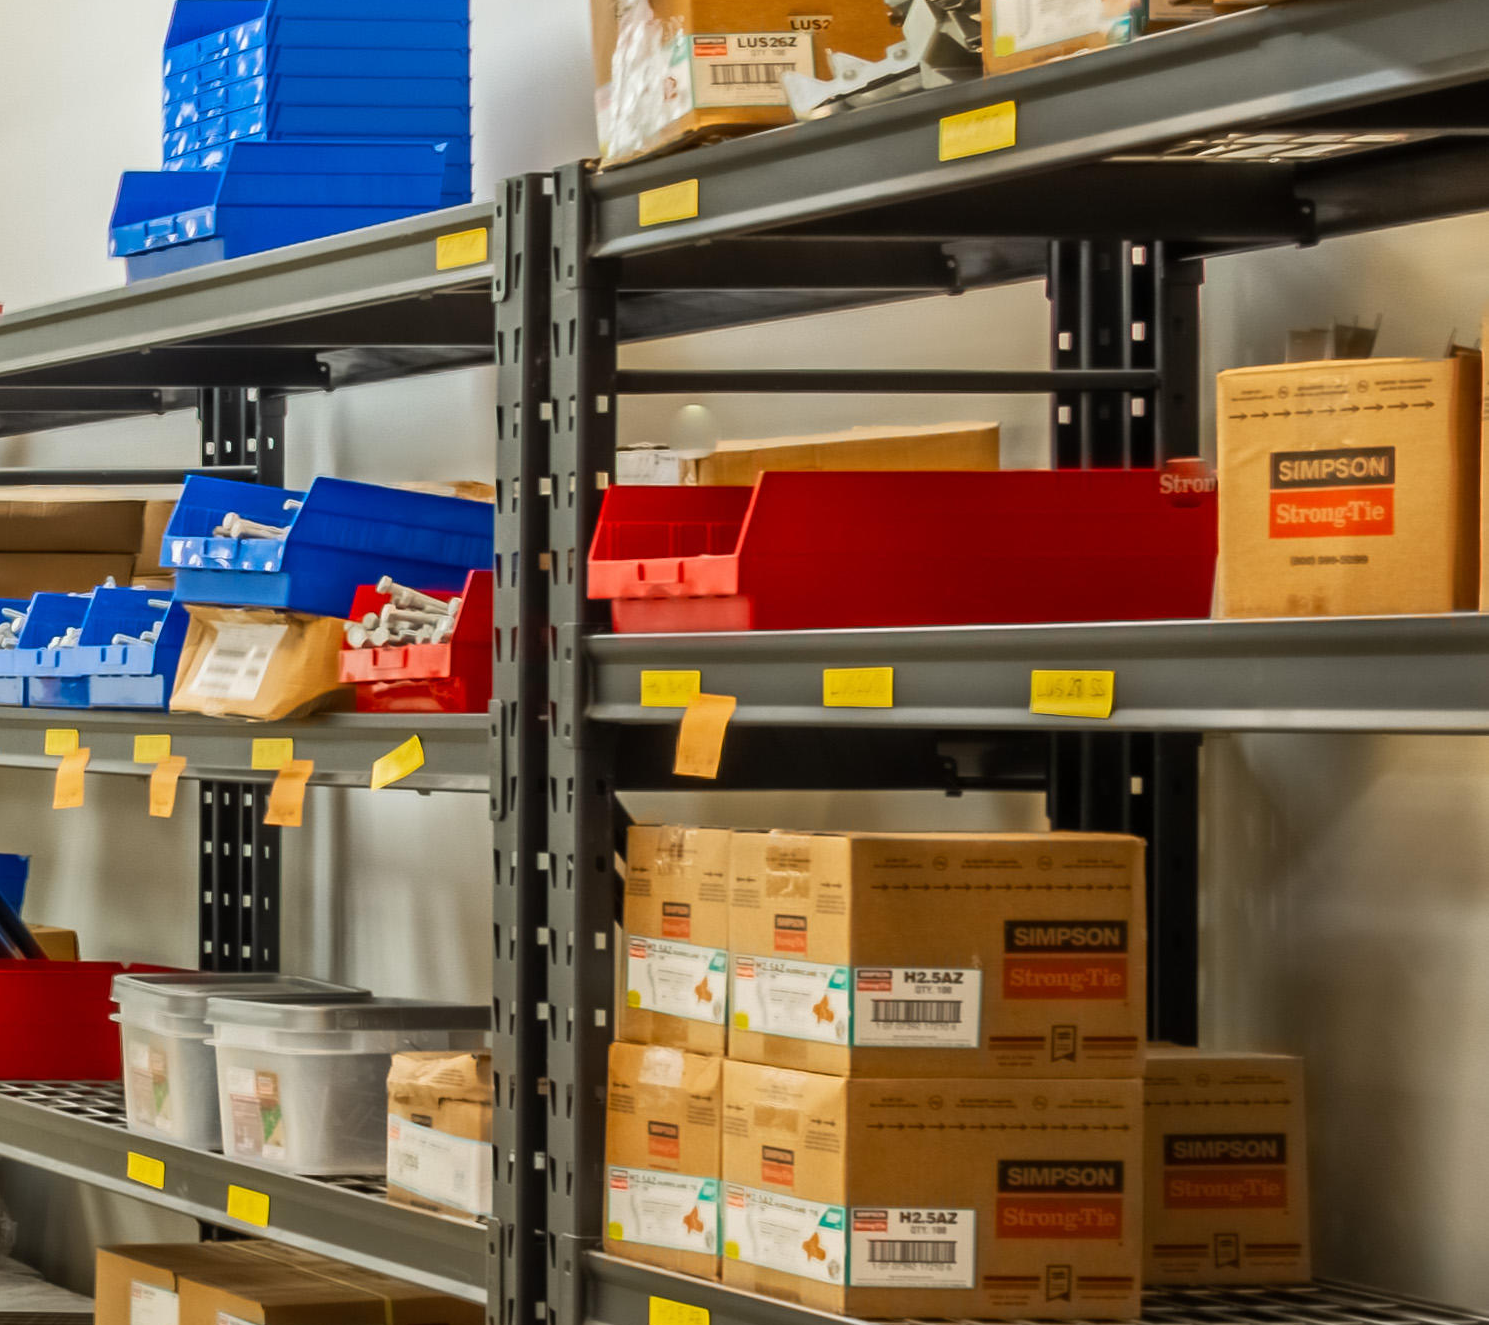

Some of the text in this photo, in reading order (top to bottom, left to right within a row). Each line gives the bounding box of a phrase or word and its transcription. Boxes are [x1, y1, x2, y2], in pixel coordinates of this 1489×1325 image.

[737, 36, 798, 49] LUS26Z
[1279, 457, 1388, 482] SIMPSON
[1276, 501, 1385, 528] Strong-Tie
[1014, 927, 1120, 947] SIMPSON
[903, 971, 964, 985] H2.5AZ
[1010, 967, 1121, 992] Strong-Tie
[1173, 1139, 1278, 1159] SIMPSON
[1007, 1167, 1115, 1187] SIMPSON
[1170, 1178, 1281, 1201] Strong-Tie
[899, 1211, 958, 1225] H2.5AZ
[1002, 1207, 1116, 1231] Strong-Tie
